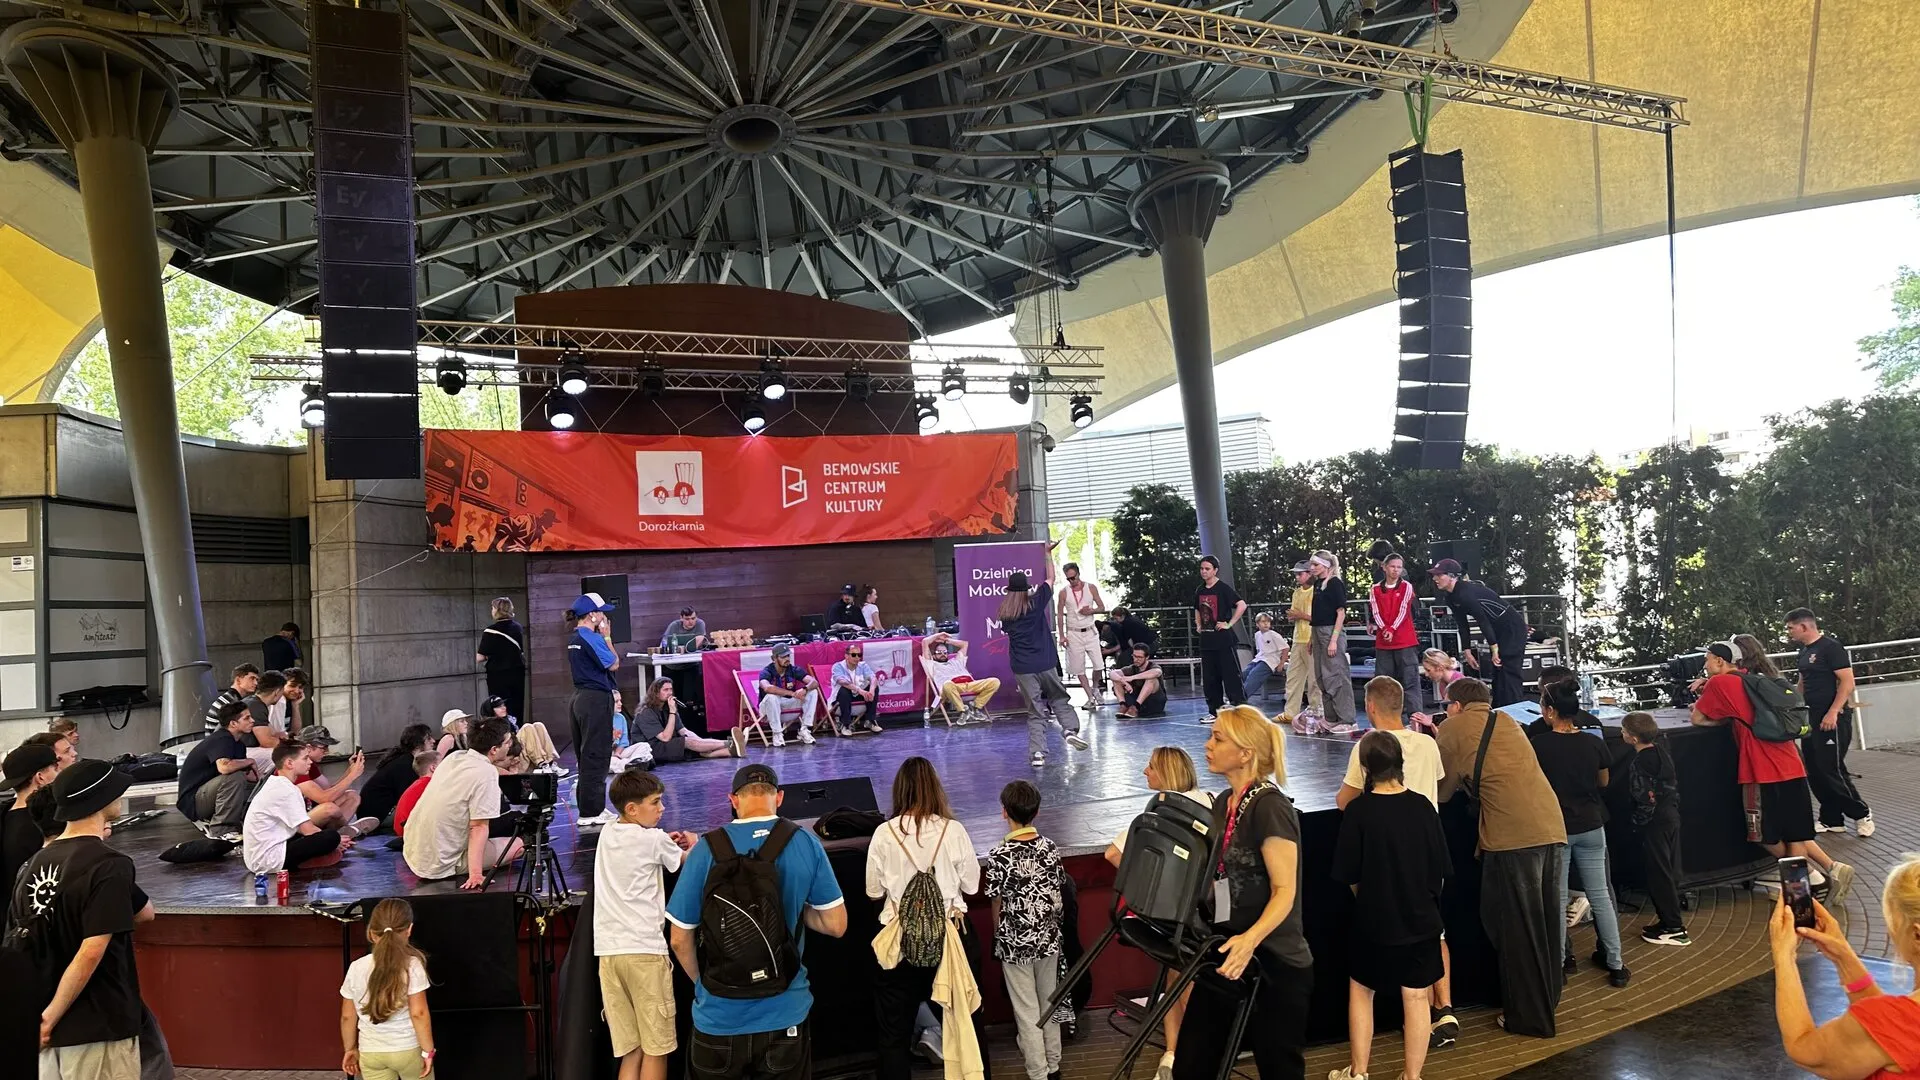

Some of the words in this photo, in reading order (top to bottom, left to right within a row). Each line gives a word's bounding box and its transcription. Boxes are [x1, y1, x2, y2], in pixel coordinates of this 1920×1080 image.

[823, 462, 901, 476] BEMOWSKIE
[824, 481, 886, 495] CENTRUM
[825, 499, 883, 513] KULTURY
[639, 521, 705, 532] Dorożkarnia
